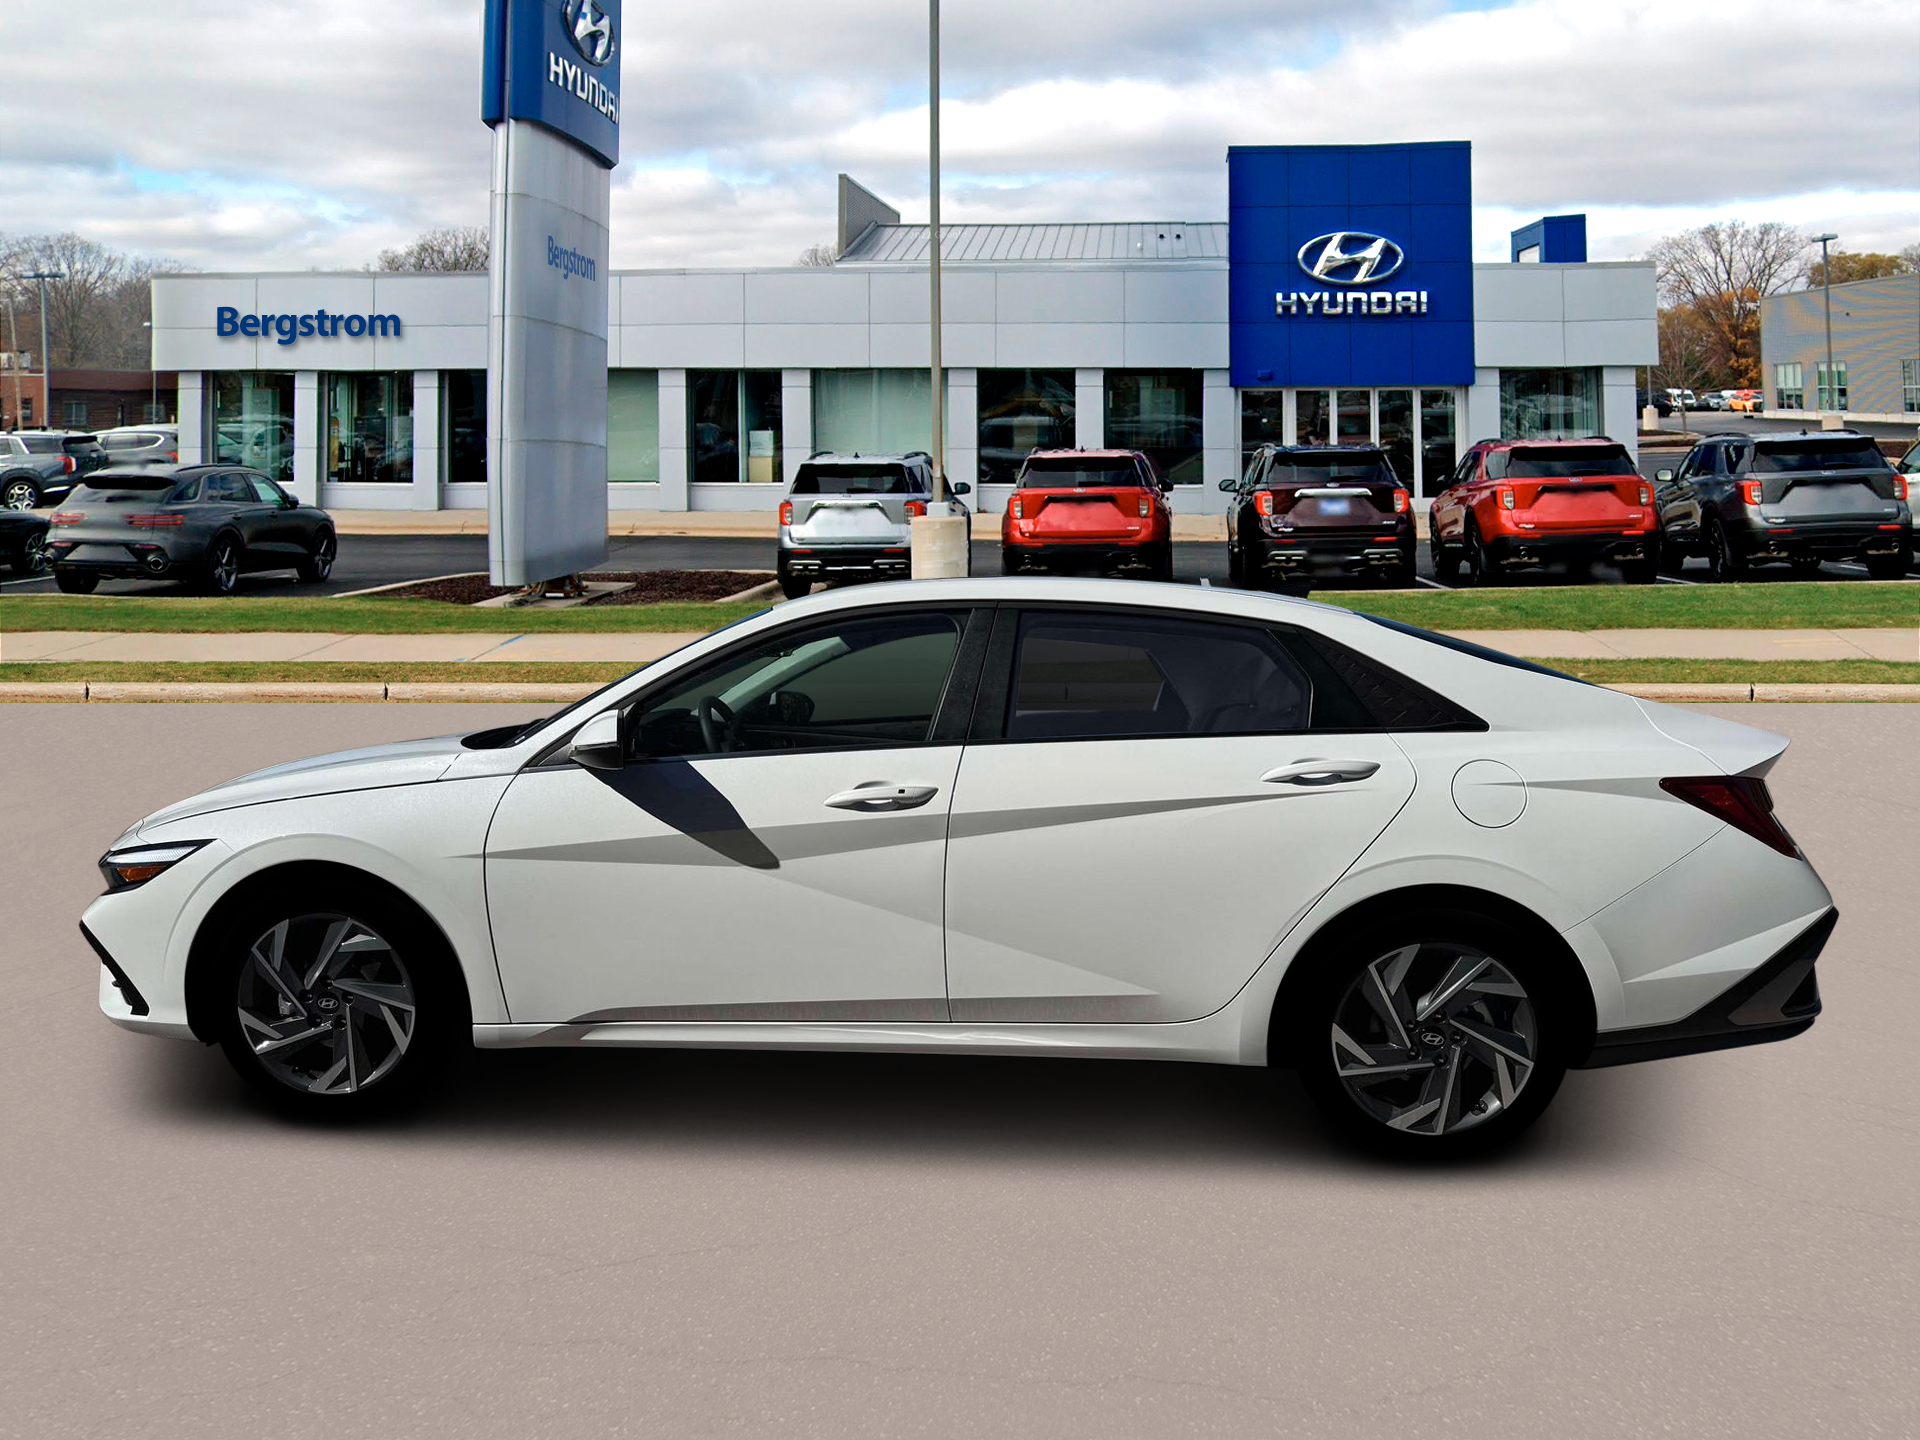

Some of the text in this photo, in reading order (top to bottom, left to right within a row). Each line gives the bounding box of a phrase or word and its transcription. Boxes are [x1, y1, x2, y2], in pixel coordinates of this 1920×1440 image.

[549, 52, 619, 124] HYUNDAI
[548, 235, 595, 281] Bergstrom
[1276, 291, 1427, 315] HYUNDAI
[217, 306, 401, 345] Bergstrom
